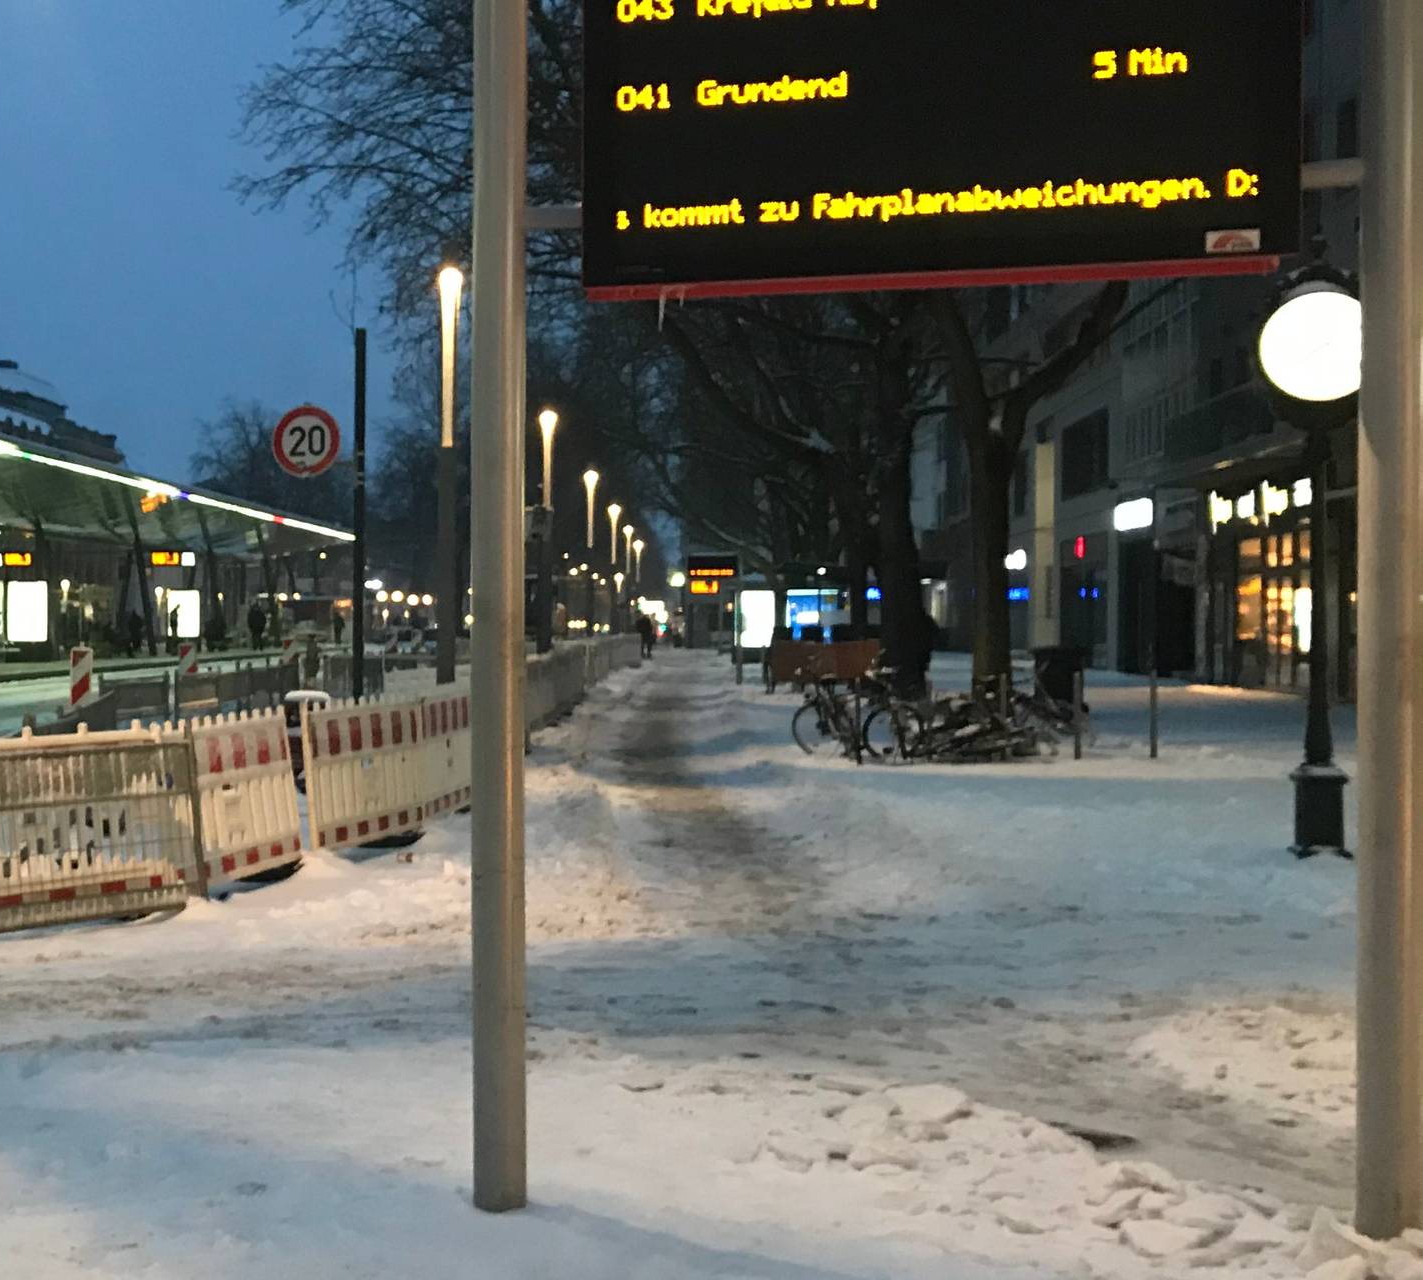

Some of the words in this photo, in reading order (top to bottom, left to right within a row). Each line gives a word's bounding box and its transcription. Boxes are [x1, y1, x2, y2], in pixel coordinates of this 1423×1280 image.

[617, 0, 674, 23] 043
[617, 85, 671, 111] 041
[696, 71, 849, 106] Grundend
[1093, 51, 1118, 79] 5
[1127, 47, 1188, 77] Min
[644, 198, 745, 228] kommt
[759, 201, 800, 222] zu
[813, 177, 1212, 223] Fahrplanabweichungen.
[289, 425, 325, 456] 20
